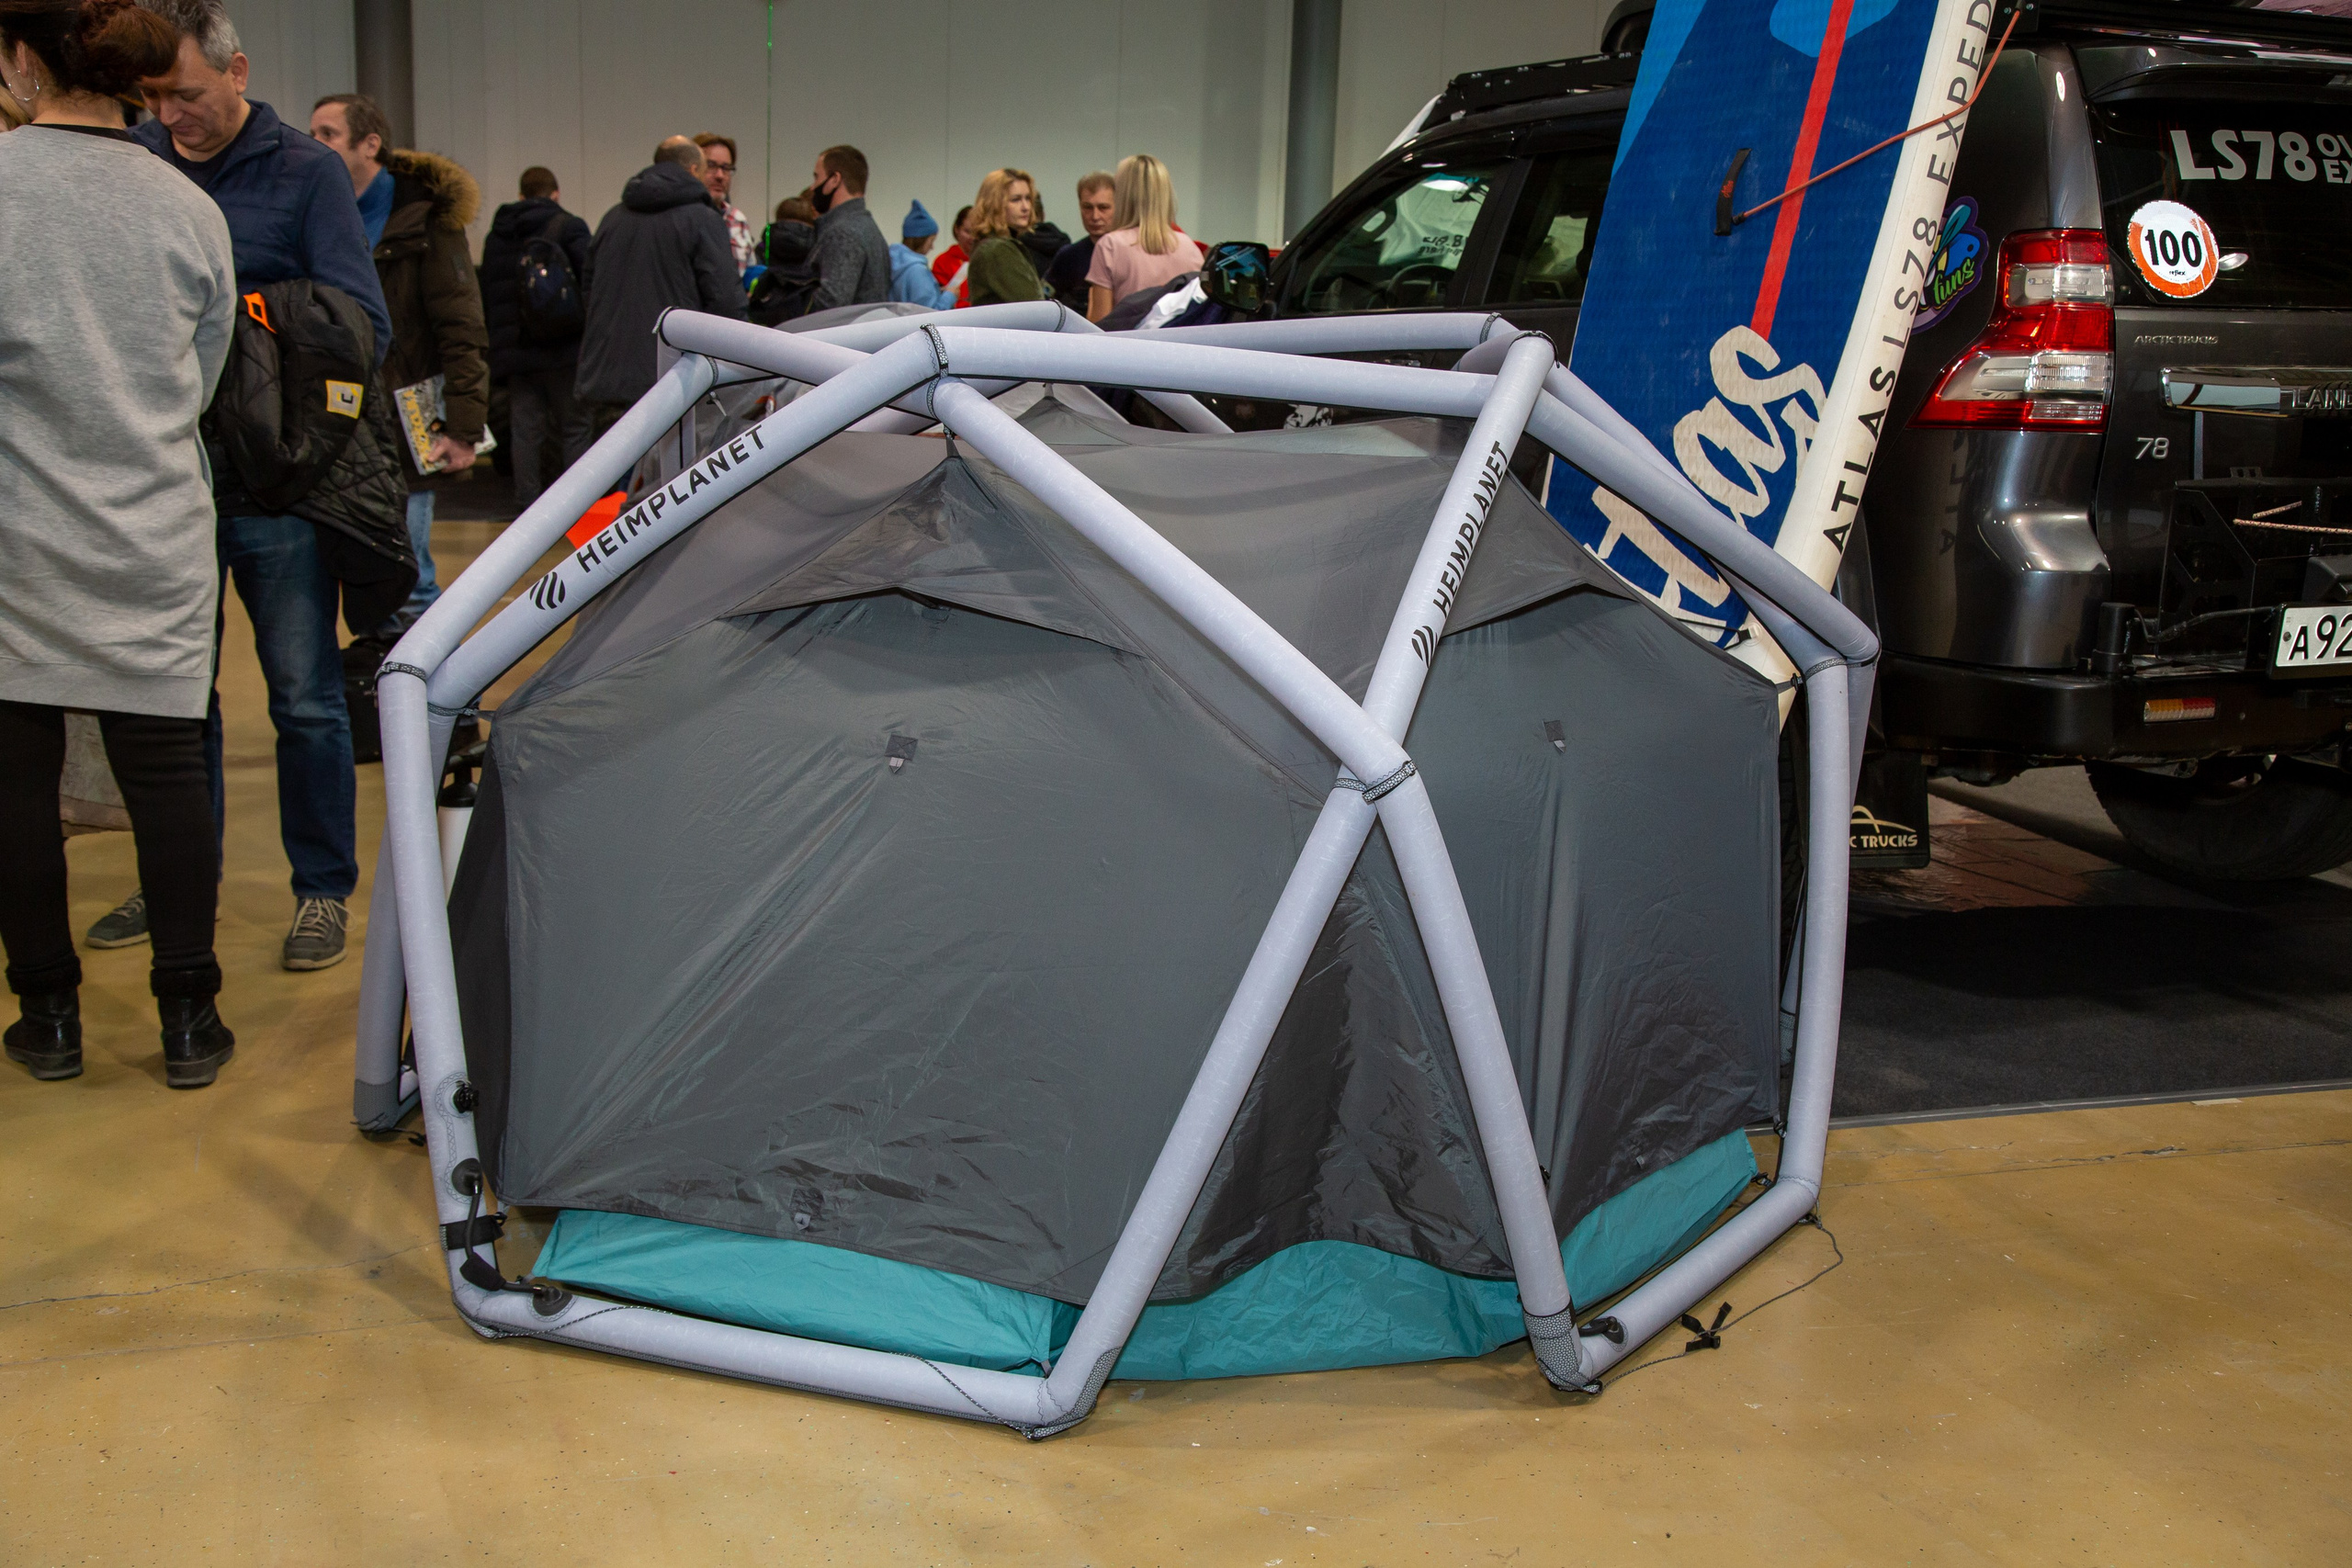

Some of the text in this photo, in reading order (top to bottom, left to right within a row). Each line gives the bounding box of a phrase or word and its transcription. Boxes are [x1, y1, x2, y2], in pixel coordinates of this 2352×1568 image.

[2170, 129, 2317, 182] LS78
[2144, 229, 2202, 267] 100
[1823, 0, 1995, 555] ATLAS LS78 EXPED
[2136, 437, 2169, 459] 78
[576, 424, 764, 573] HEIMPLANET
[1433, 440, 1508, 619] HEIMPLANET
[1860, 834, 1918, 849] TRUCKS
